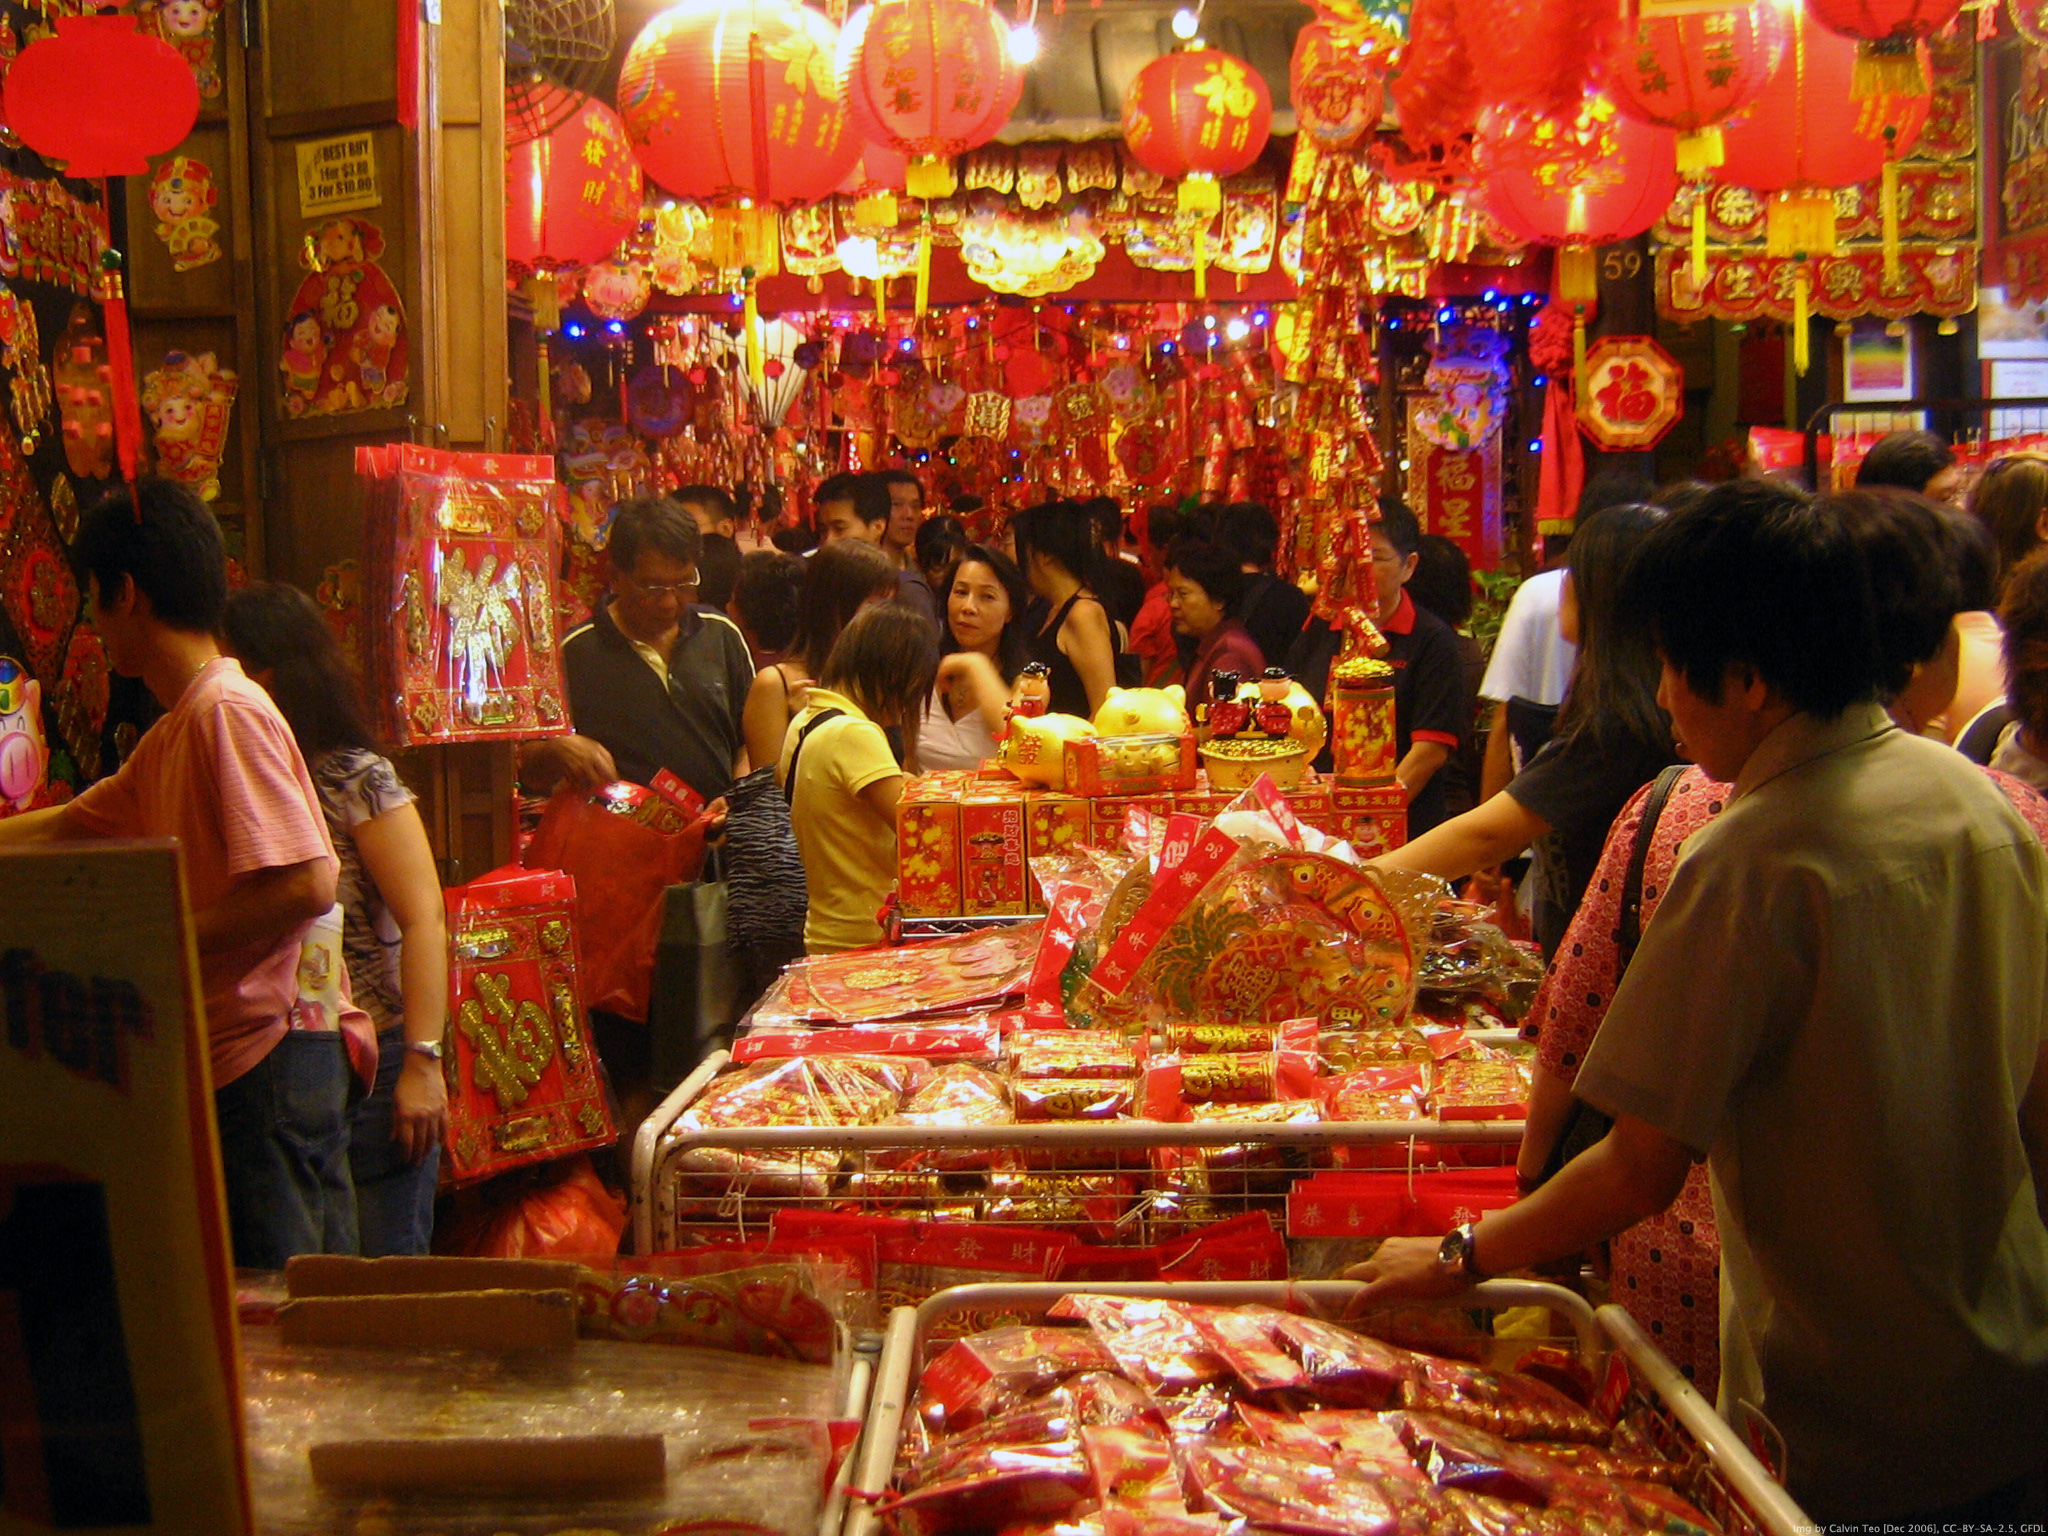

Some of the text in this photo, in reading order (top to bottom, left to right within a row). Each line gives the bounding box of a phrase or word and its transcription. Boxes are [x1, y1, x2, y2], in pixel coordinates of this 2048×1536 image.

[1194, 59, 1257, 118] 福
[323, 138, 369, 162] BEST BUY
[1603, 251, 1641, 281] 59
[1595, 361, 1657, 422] 福
[459, 971, 553, 1109] 福
